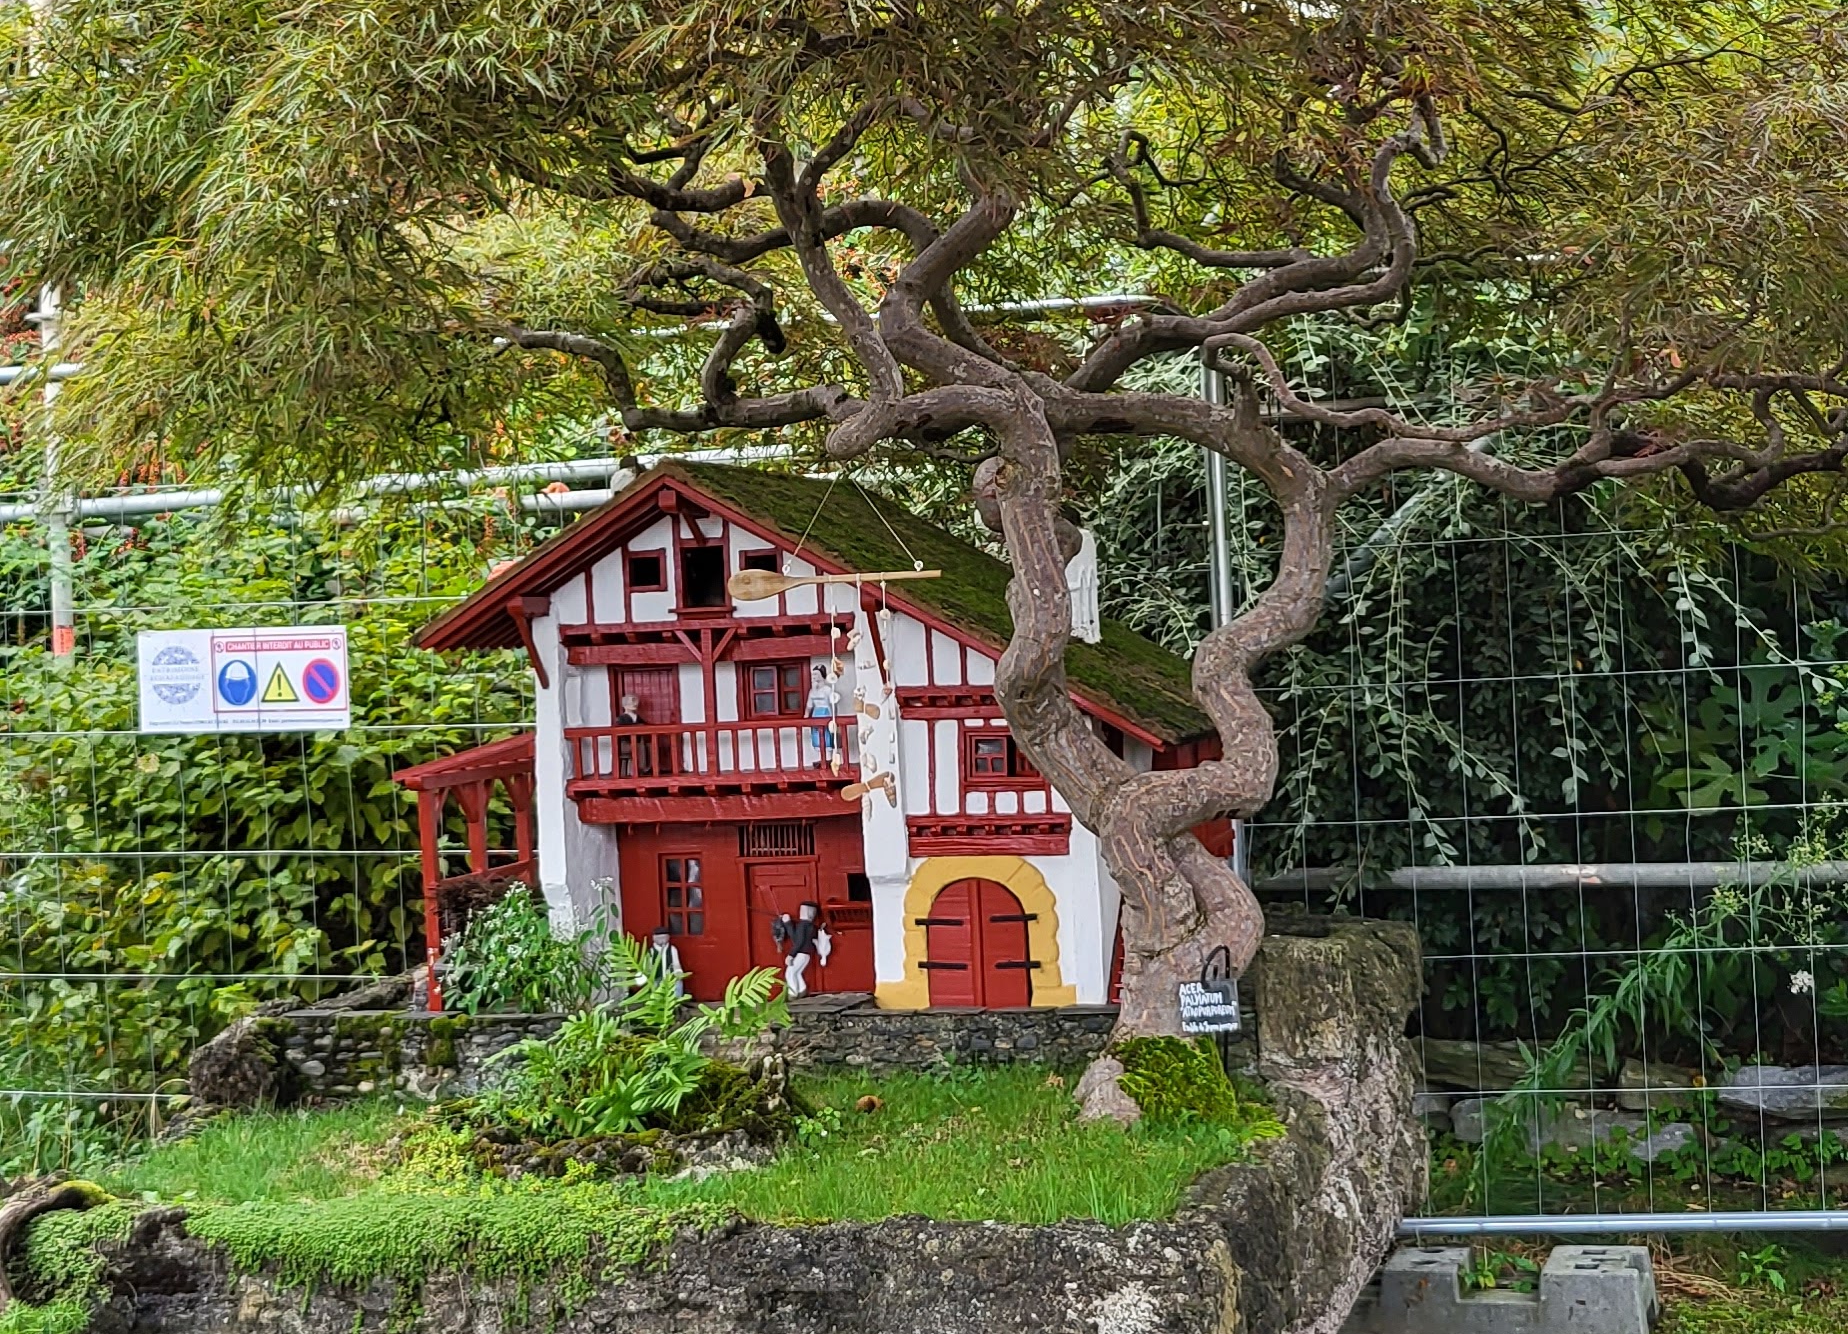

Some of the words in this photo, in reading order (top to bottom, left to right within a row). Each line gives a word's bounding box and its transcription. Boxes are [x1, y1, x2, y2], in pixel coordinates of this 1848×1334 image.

[227, 641, 261, 651] CHANTIER
[262, 641, 293, 650] INTERDIT
[294, 640, 304, 649] AU
[304, 639, 330, 649] PUBLIC
[1179, 982, 1205, 995] ACER
[1180, 992, 1223, 1009] PALMATUM
